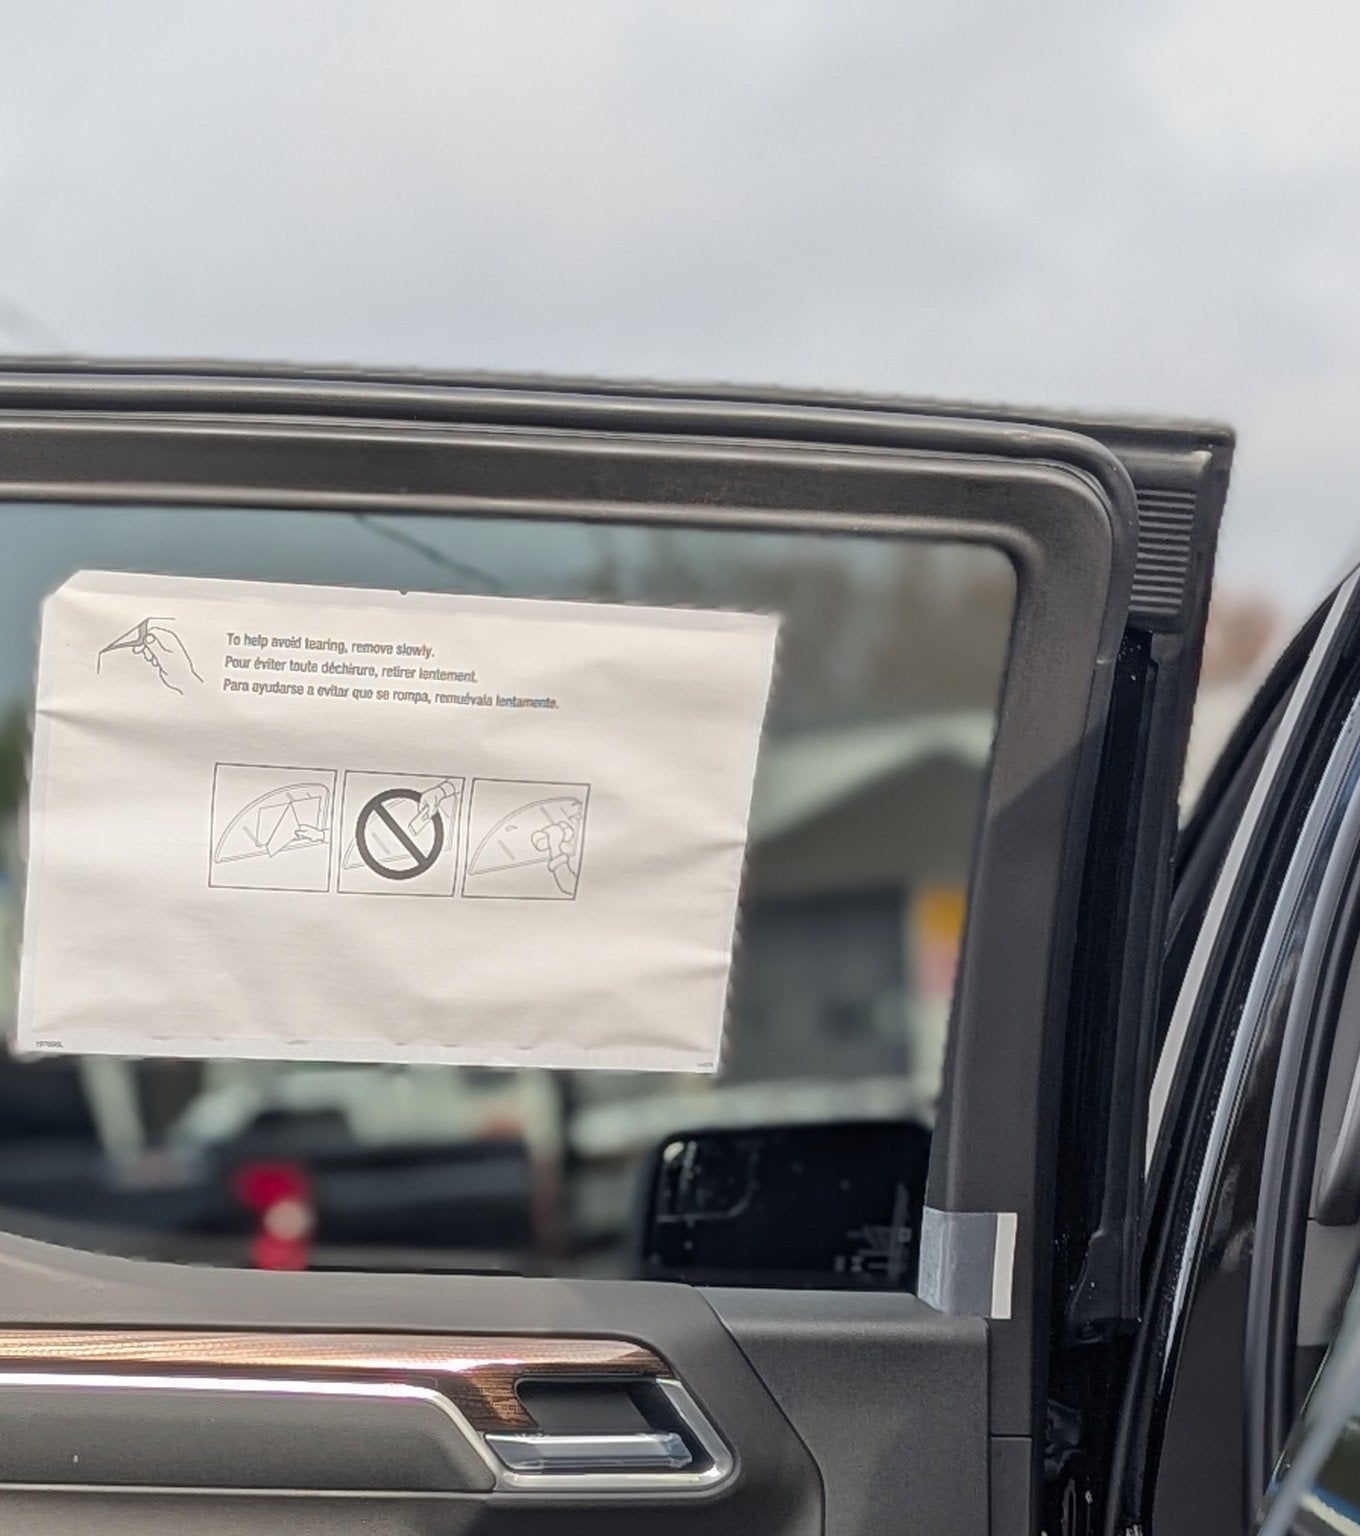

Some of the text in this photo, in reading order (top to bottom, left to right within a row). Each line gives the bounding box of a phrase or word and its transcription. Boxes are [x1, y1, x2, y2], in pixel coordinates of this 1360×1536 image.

[226, 632, 435, 660] To help avoid tearing, remove slowly.
[224, 654, 478, 683] Pour éviter toute déchirure, retirer lentement.
[223, 677, 250, 692] Para
[251, 680, 304, 696] ayudarse
[306, 685, 315, 696] a
[316, 684, 350, 698] evitar
[351, 687, 374, 701] que
[376, 689, 390, 701] se
[392, 690, 432, 705] rompa,
[495, 694, 559, 710] lentamente.
